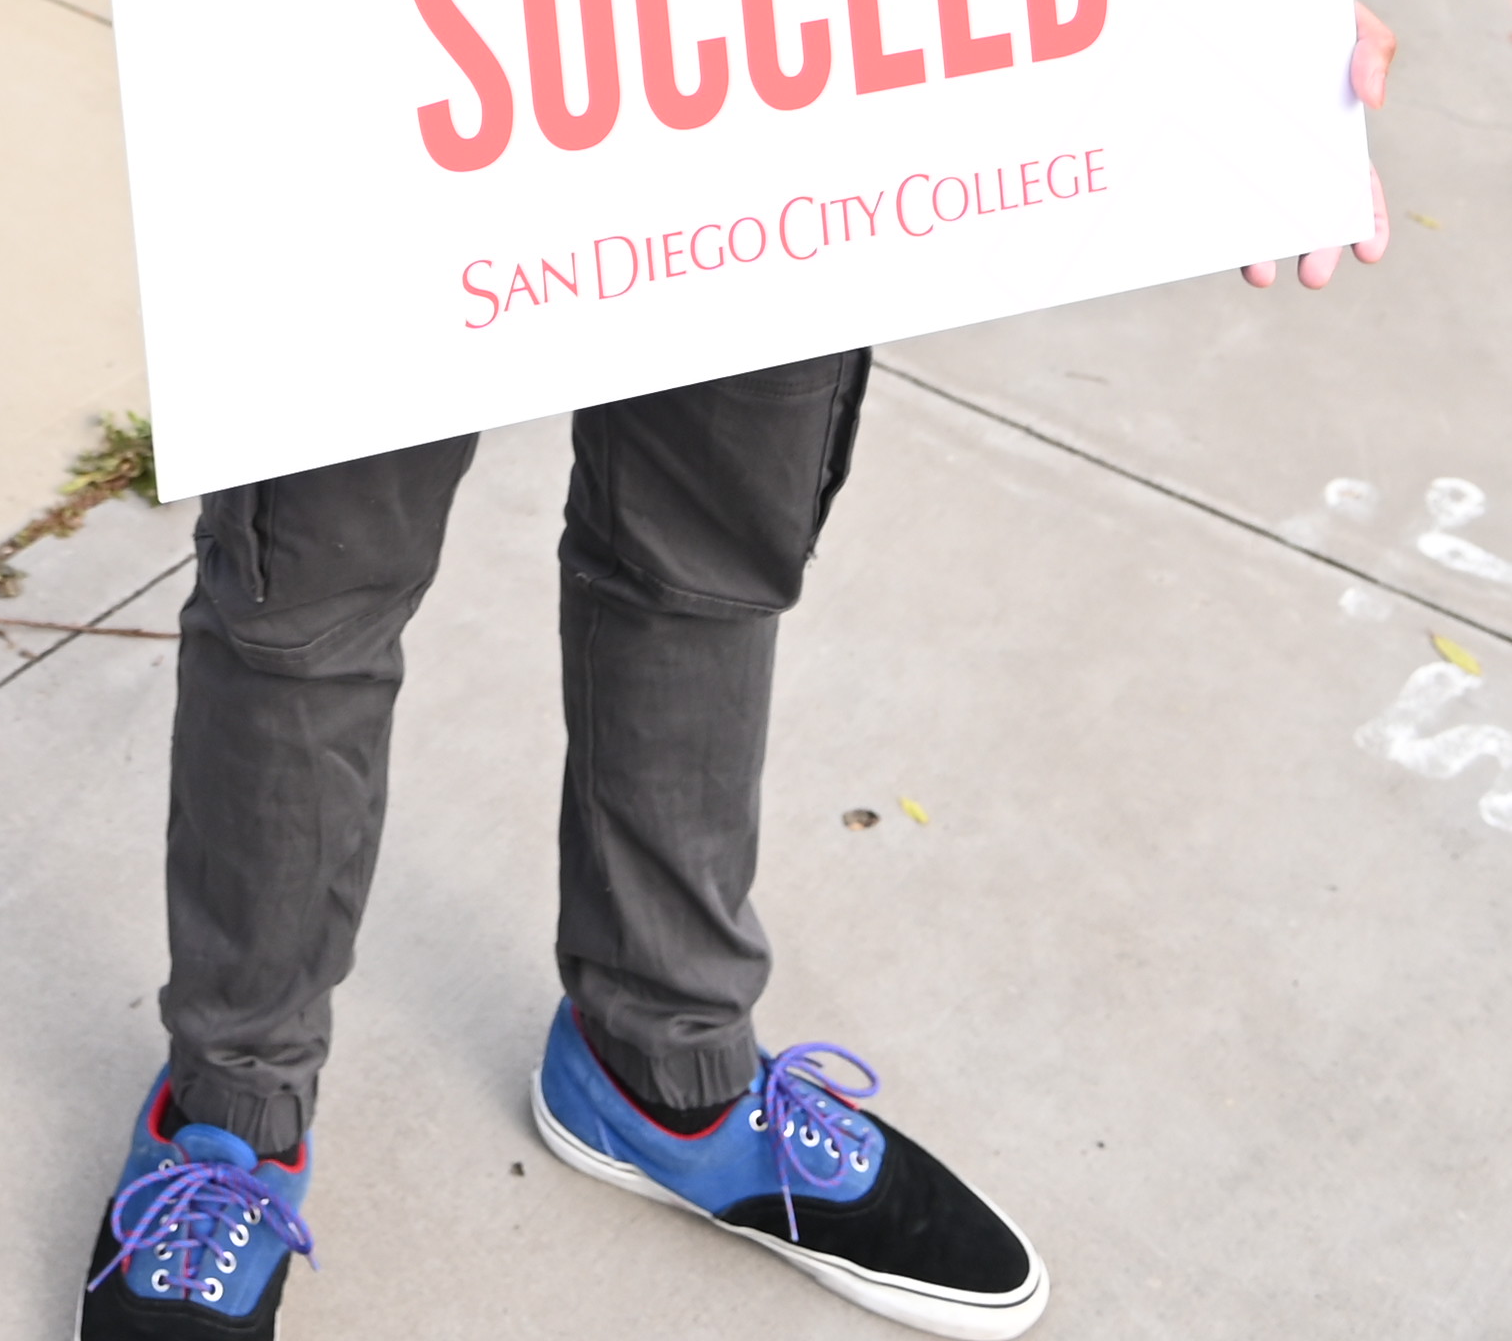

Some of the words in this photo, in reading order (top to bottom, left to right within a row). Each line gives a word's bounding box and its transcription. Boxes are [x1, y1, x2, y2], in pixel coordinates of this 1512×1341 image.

[462, 253, 578, 329] SAN
[594, 217, 766, 301] DIEGO
[779, 191, 884, 260] CITY
[896, 149, 1107, 237] COLLEGE
